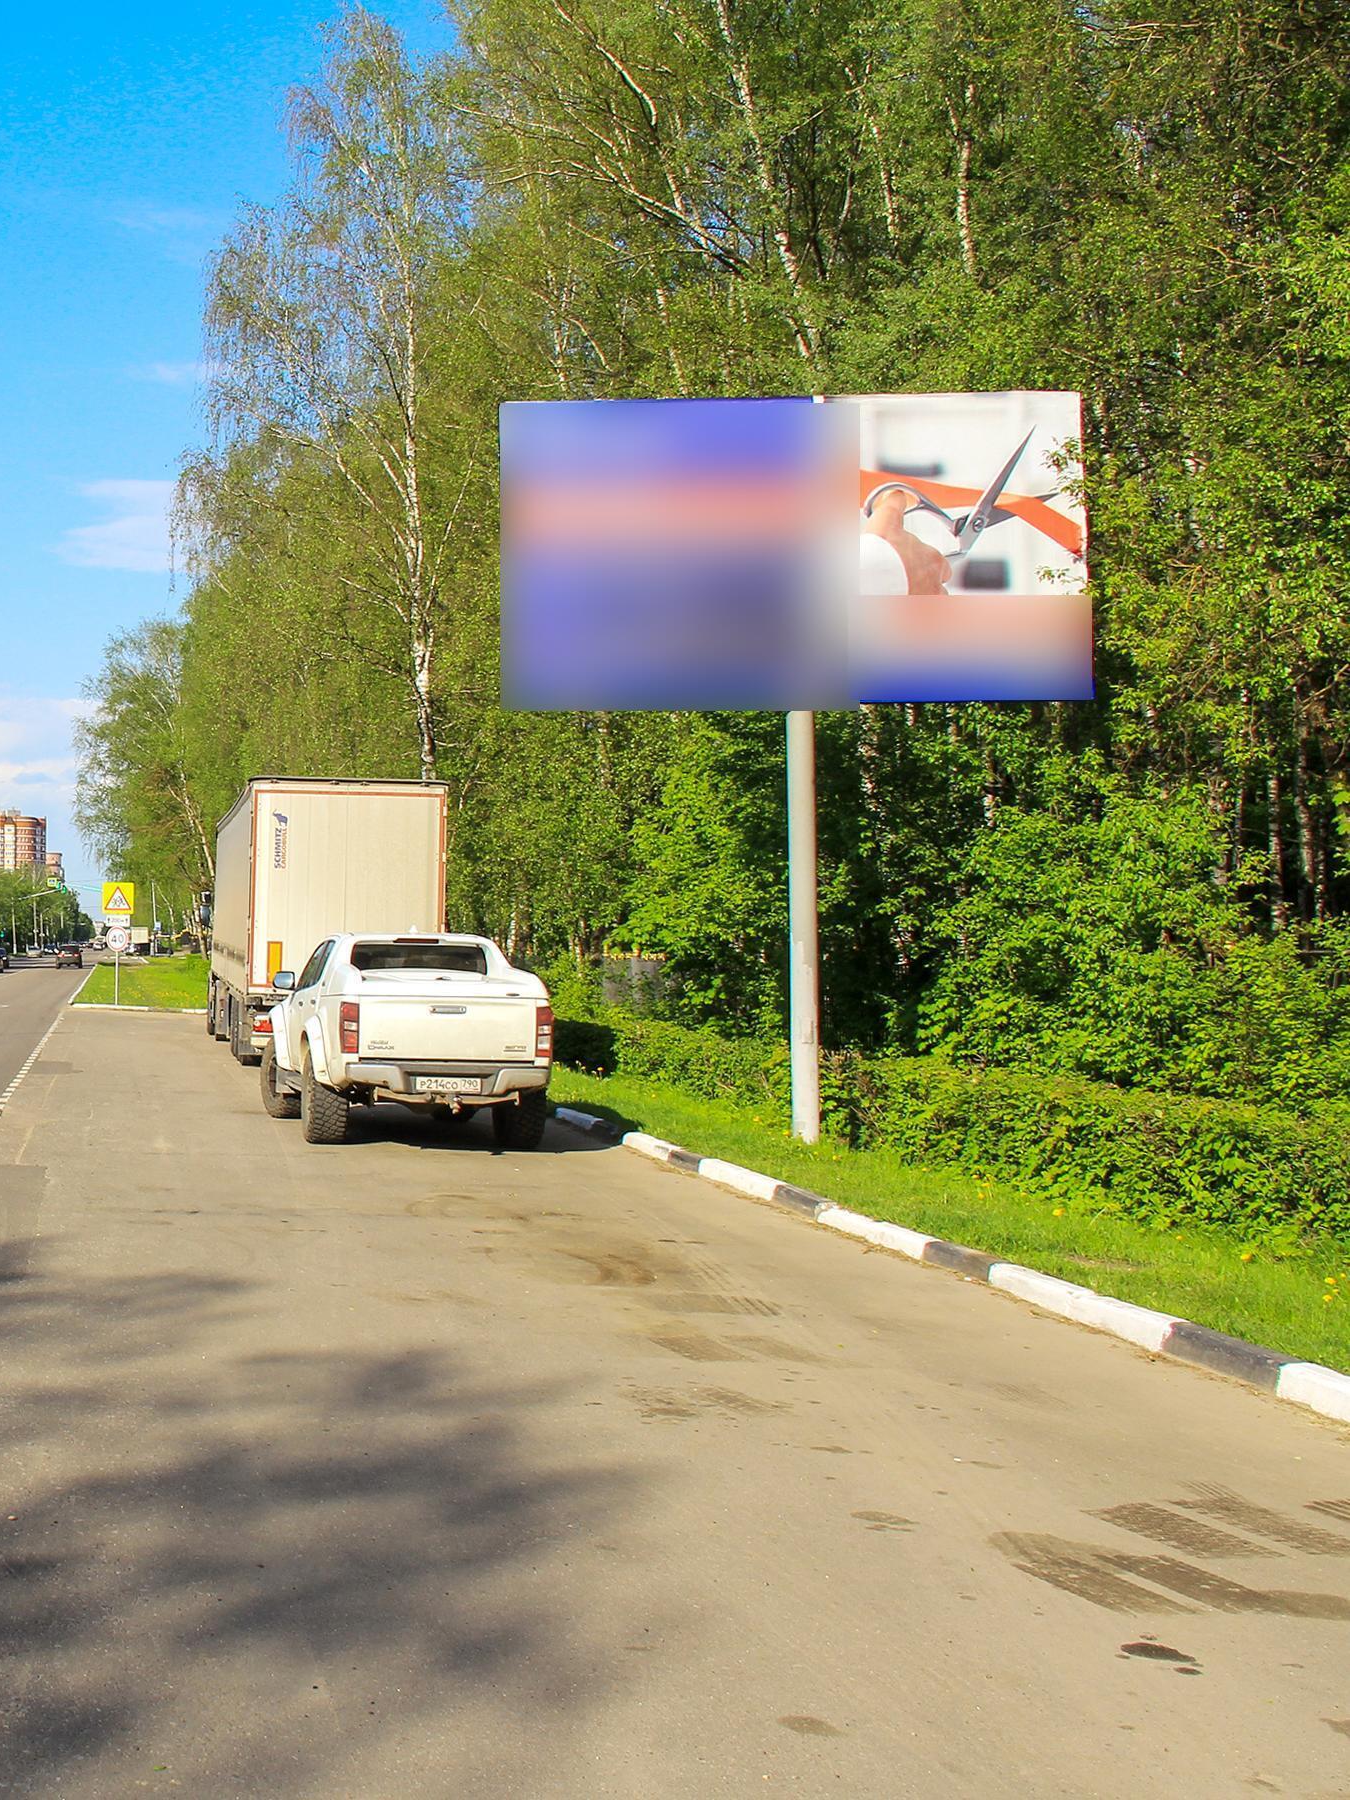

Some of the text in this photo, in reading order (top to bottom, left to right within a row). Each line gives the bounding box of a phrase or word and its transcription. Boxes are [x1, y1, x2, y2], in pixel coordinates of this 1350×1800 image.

[274, 827, 282, 869] SCHMITZ
[111, 933, 125, 944] 40
[461, 1079, 479, 1088] 790
